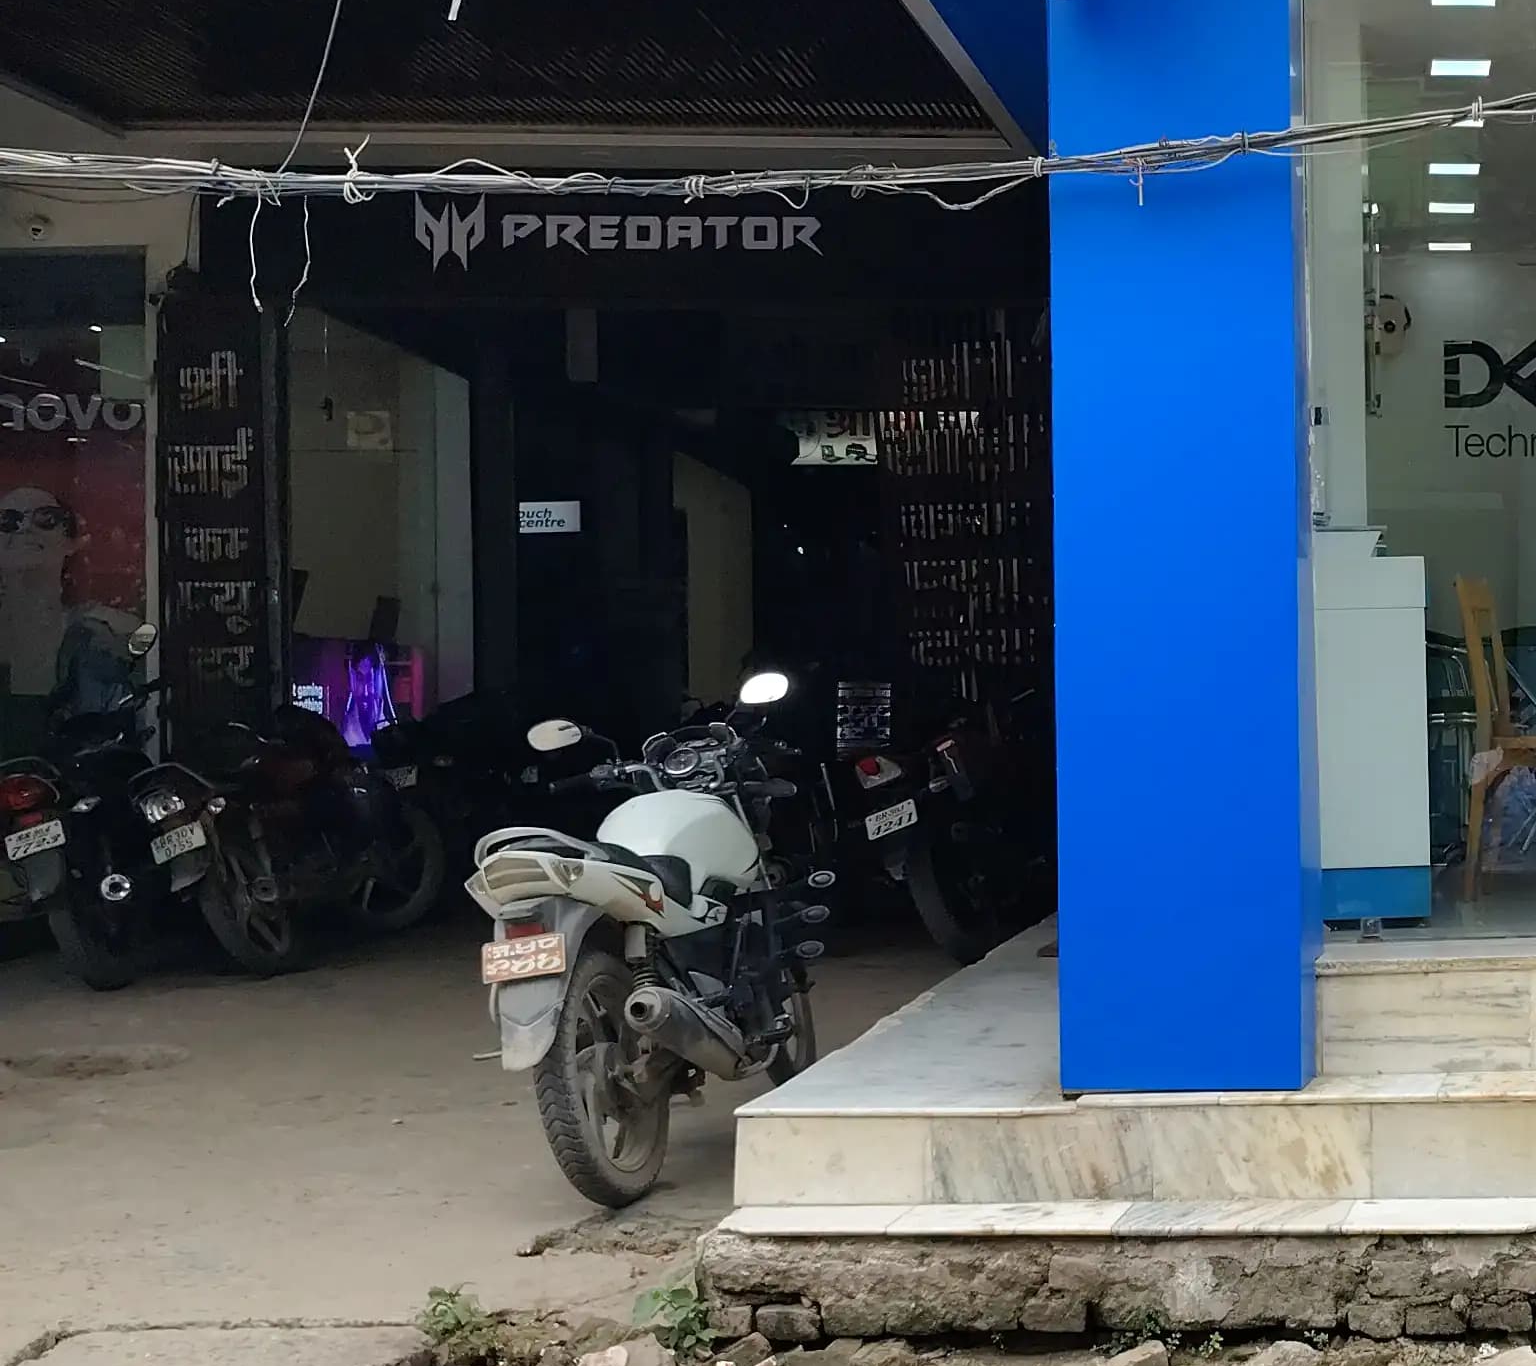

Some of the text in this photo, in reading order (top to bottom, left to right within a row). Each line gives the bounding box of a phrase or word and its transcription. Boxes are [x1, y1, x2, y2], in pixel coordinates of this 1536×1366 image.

[501, 213, 824, 257] PREDATOR
[519, 517, 566, 530] centre
[297, 681, 323, 699] gaming
[872, 812, 913, 835] 4241
